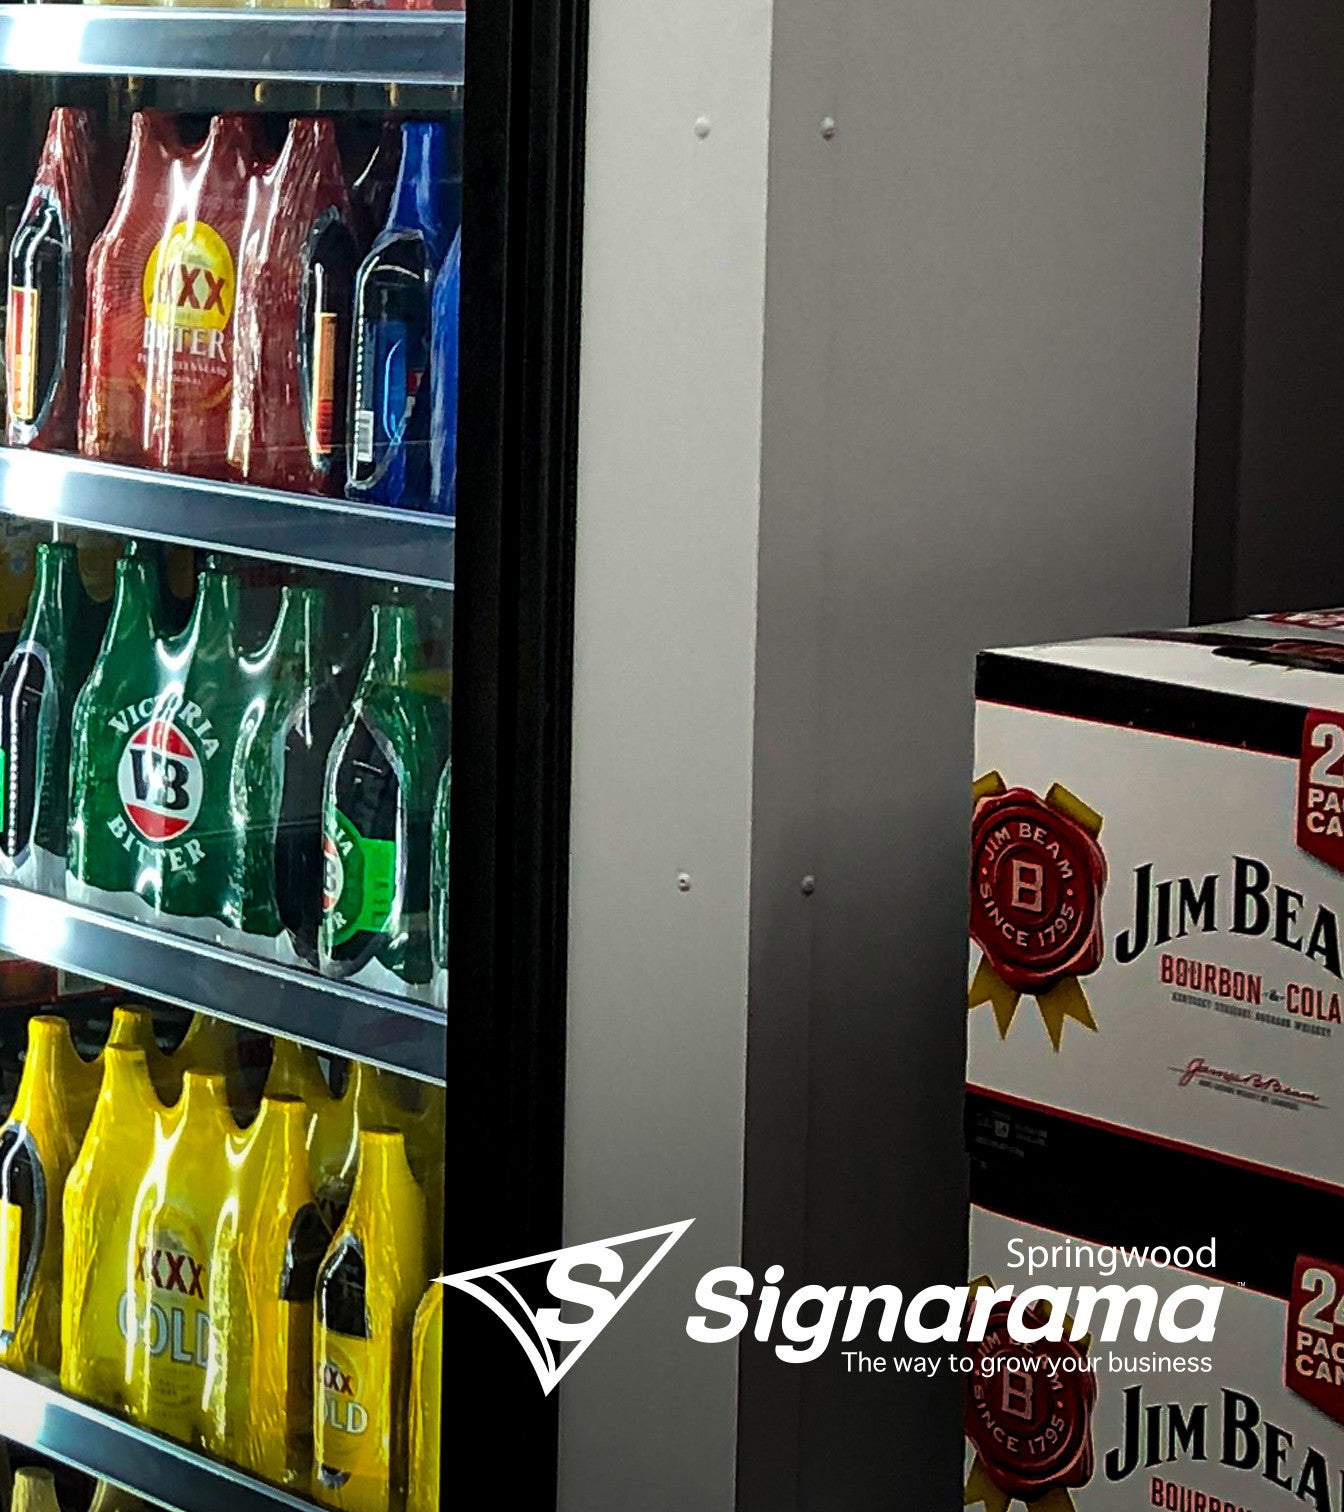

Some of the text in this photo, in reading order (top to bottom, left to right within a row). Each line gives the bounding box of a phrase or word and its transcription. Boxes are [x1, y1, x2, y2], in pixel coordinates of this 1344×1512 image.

[1309, 723, 1344, 787] 2
[106, 812, 207, 873] BITTER
[983, 822, 1074, 880] JIM BEAM
[1307, 811, 1344, 838] CA
[979, 882, 1074, 947] SINCE 1795
[1011, 859, 1044, 913] B
[1114, 854, 1344, 980] JIM BEA
[1160, 954, 1263, 1006] BOURBON
[1286, 984, 1342, 1024] COLA
[1295, 1330, 1344, 1359] PAC
[972, 1383, 1066, 1455] SINCE 1795
[1001, 1365, 1034, 1421] B
[1104, 1384, 1344, 1512] JIM BEA
